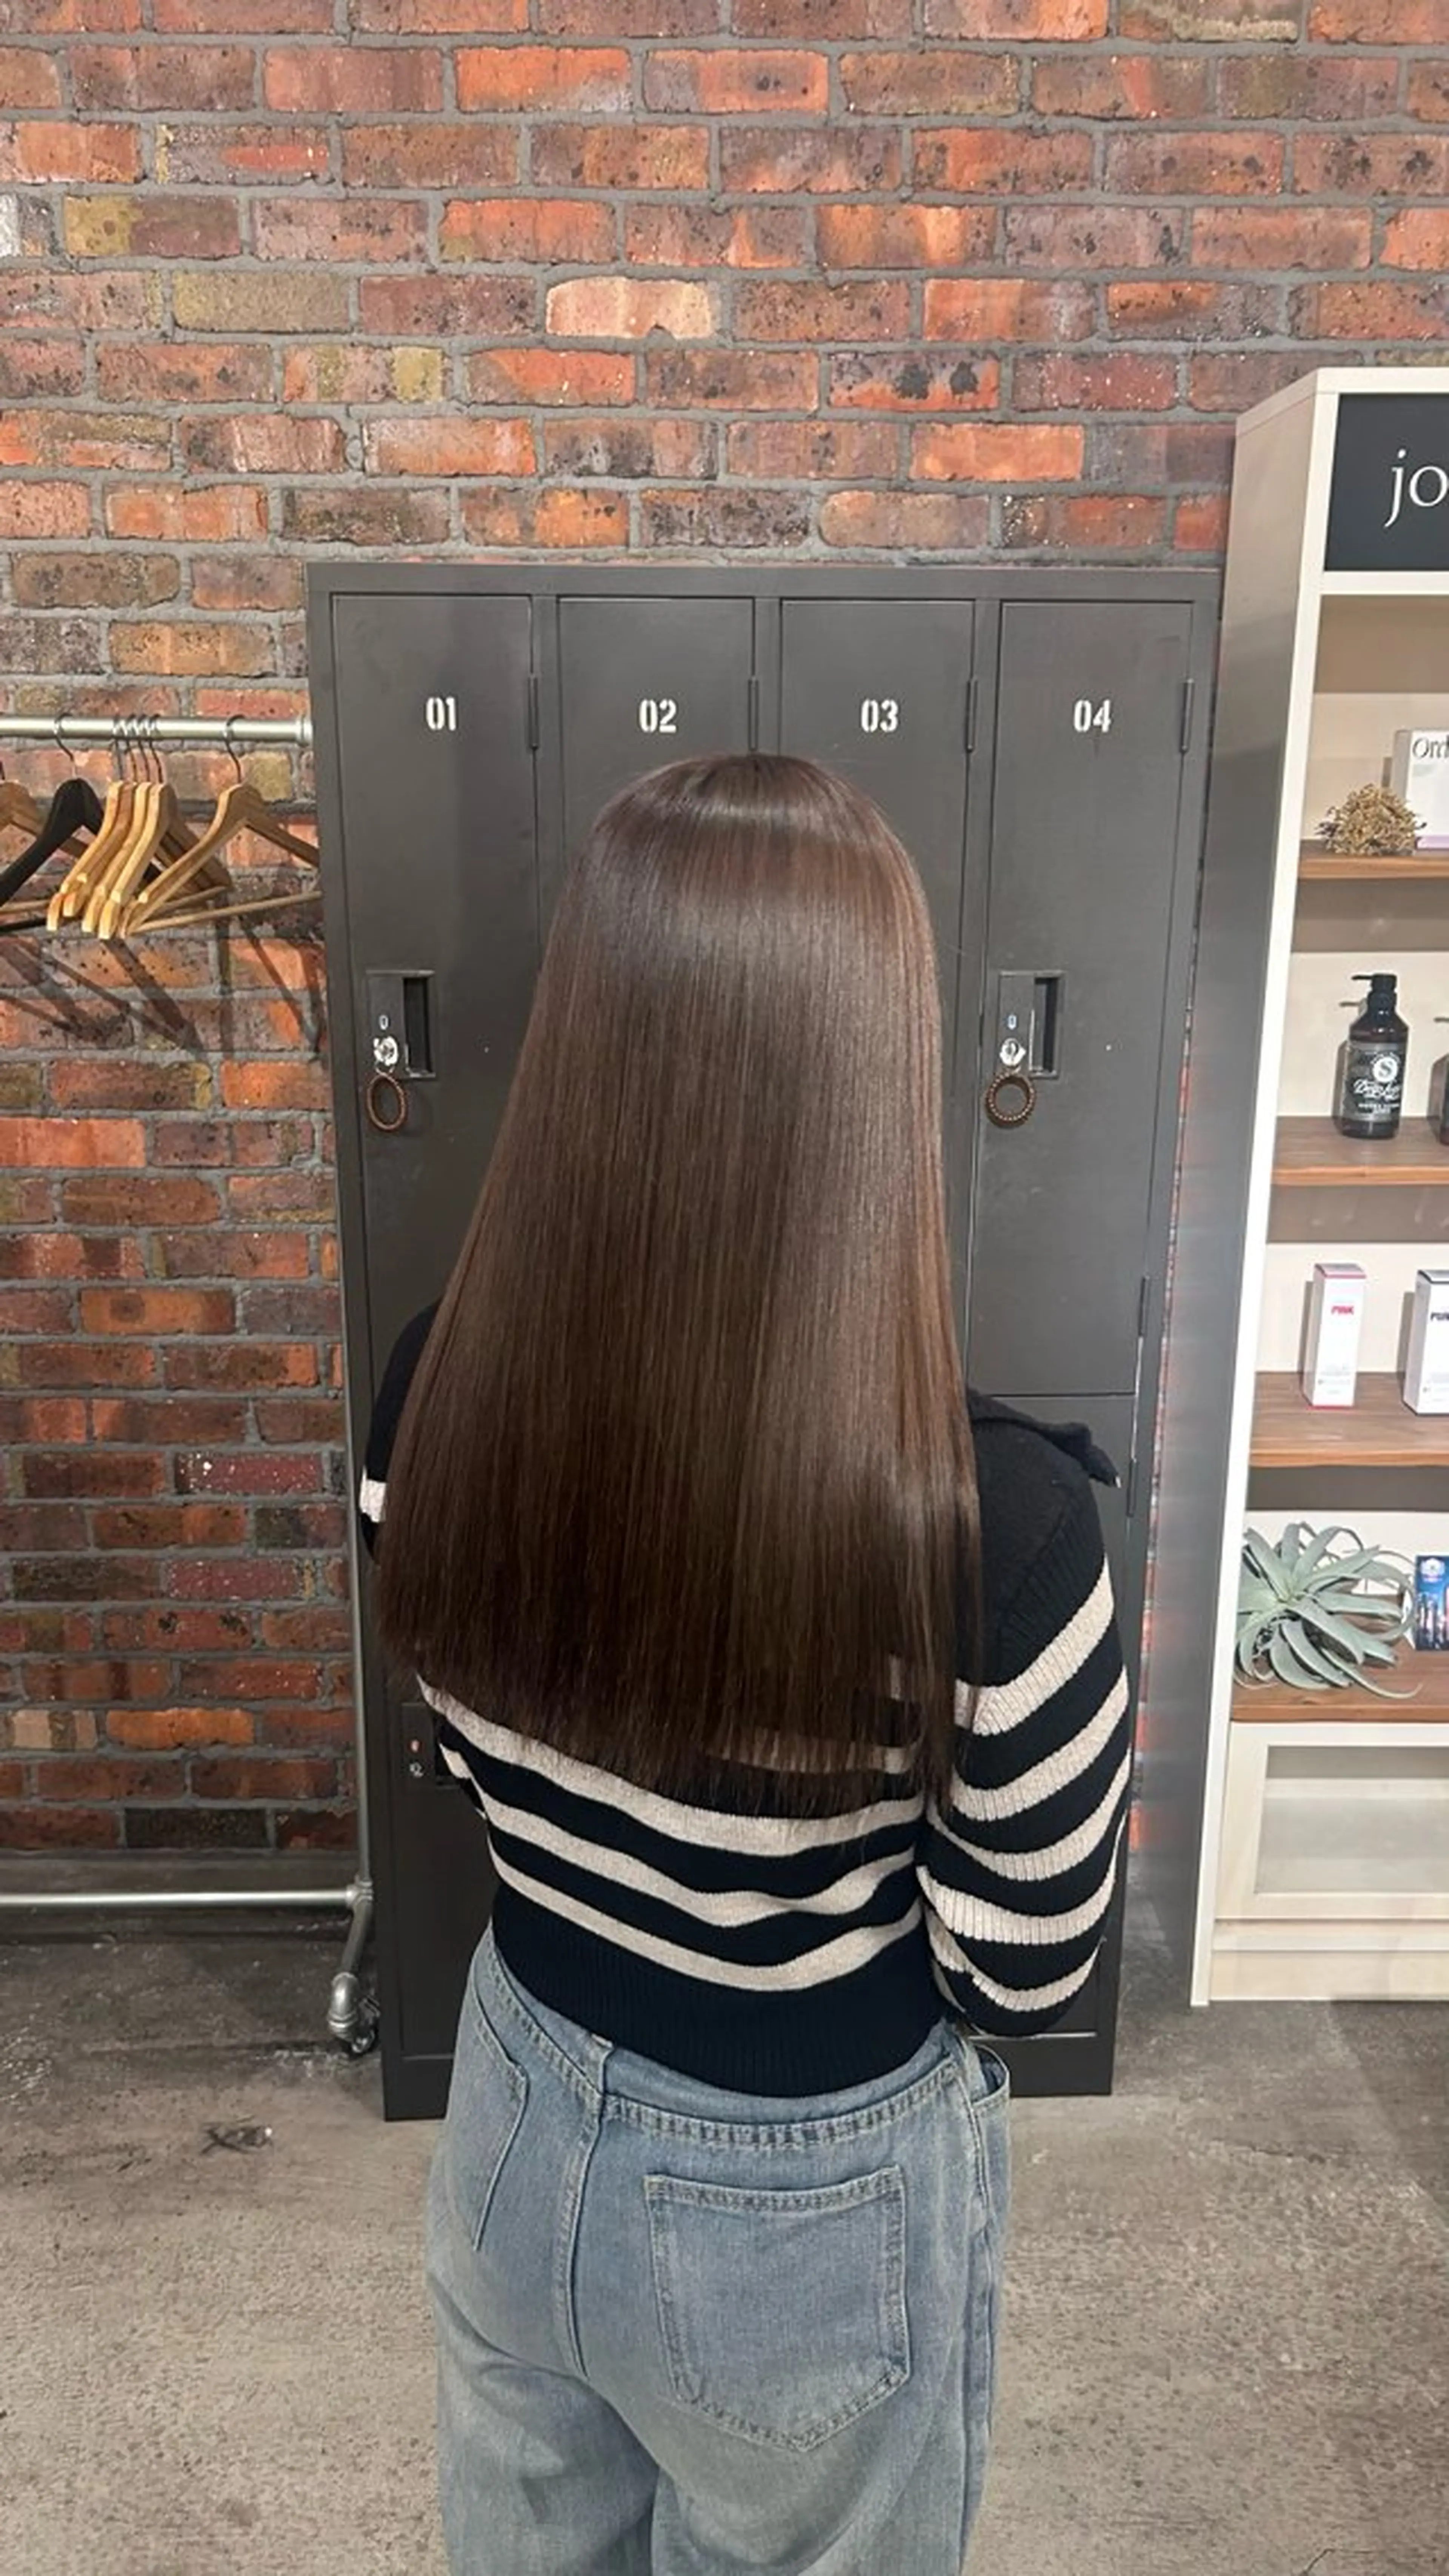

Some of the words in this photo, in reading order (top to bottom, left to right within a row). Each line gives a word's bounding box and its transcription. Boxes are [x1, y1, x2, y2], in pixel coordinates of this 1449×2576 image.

[1384, 449, 1449, 528] jo
[426, 697, 456, 731] 01
[639, 699, 677, 733] 02
[861, 699, 898, 732] 03
[1073, 699, 1111, 733] 04
